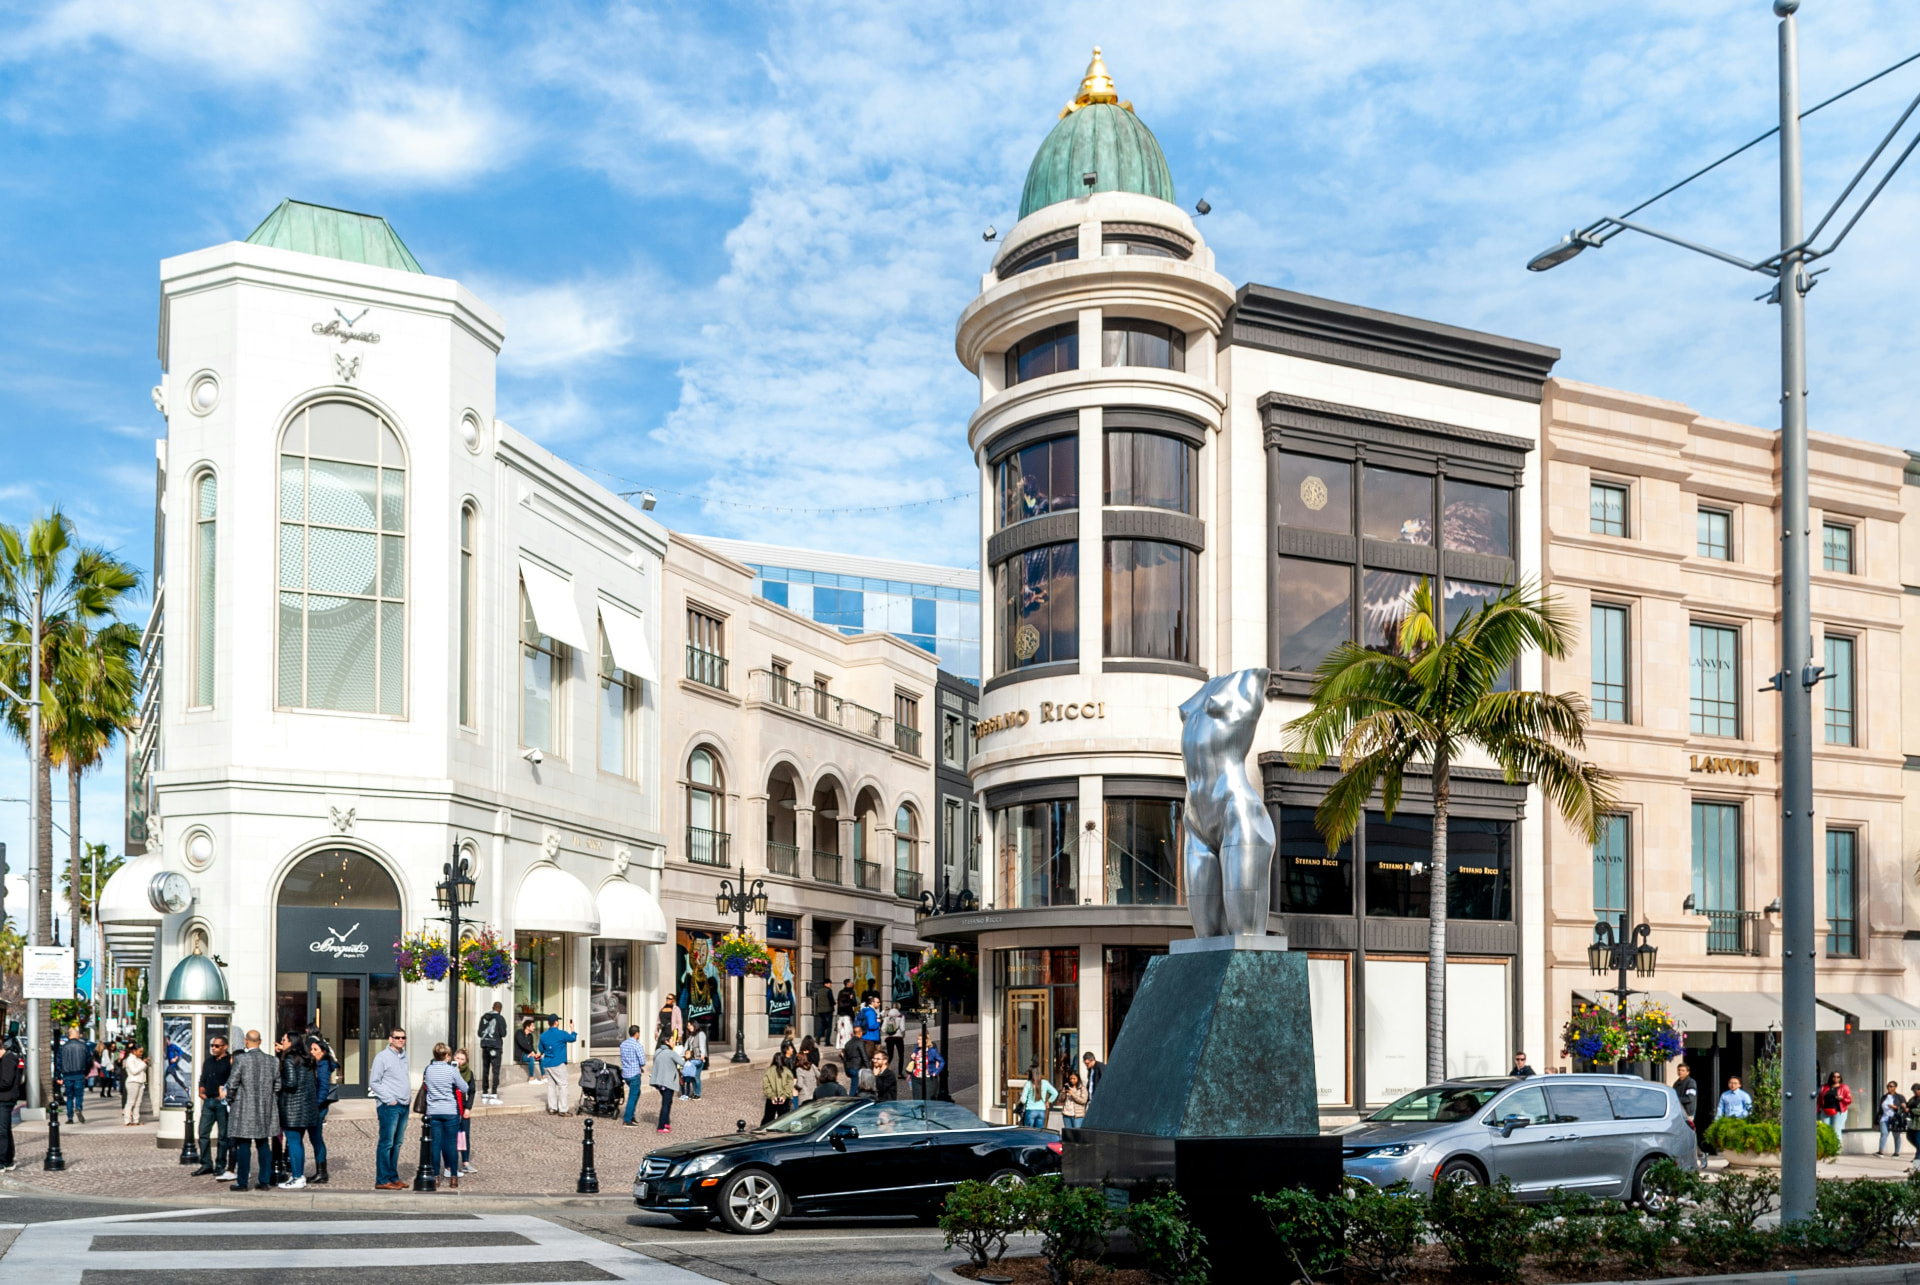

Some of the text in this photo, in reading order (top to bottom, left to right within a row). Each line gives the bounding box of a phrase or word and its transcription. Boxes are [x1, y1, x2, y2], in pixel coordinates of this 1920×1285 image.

[1690, 755, 1759, 777] LANVIN
[1593, 855, 1622, 863] ANVIN
[309, 937, 369, 958] Breguet
[1884, 1019, 1917, 1027] LANVIN
